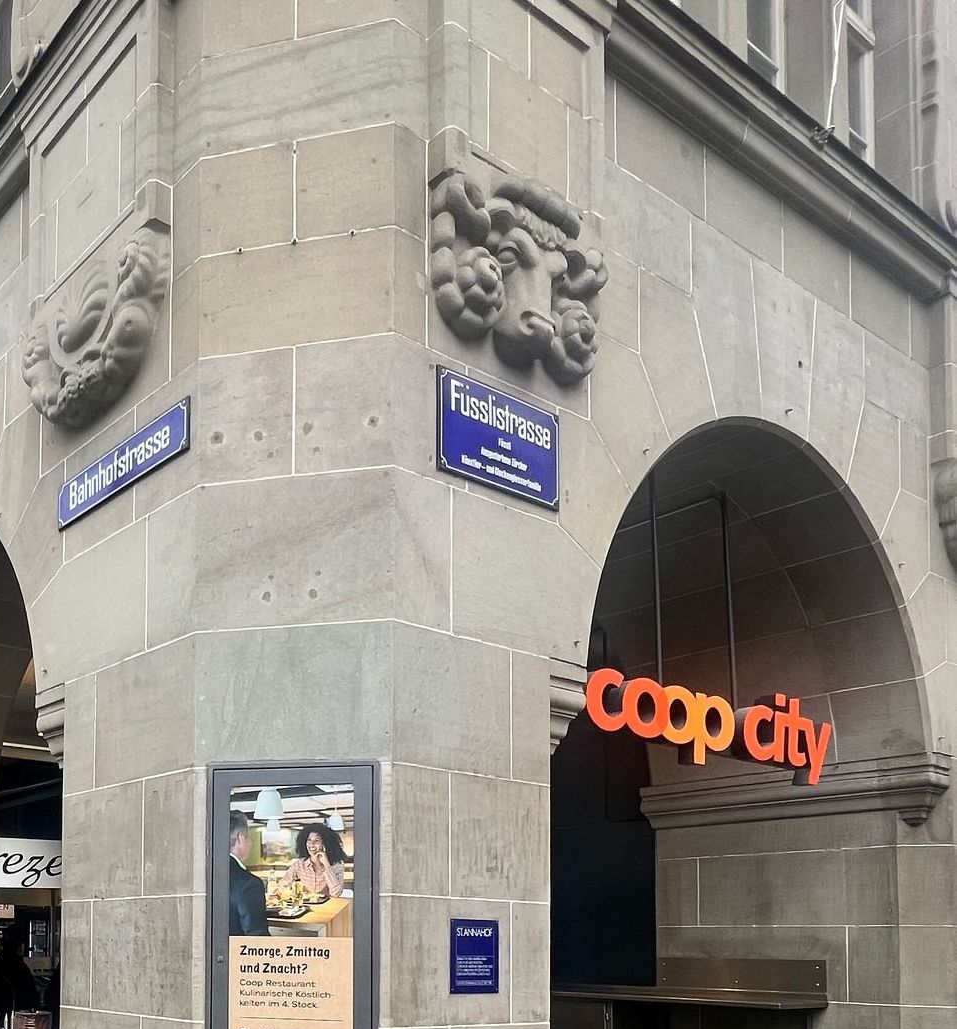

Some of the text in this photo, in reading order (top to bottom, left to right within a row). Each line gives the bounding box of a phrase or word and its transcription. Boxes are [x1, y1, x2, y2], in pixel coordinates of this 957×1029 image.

[451, 379, 551, 450] Füsslistrasse
[69, 425, 170, 511] Bahnhofstrasse
[586, 668, 832, 786] coop city
[240, 945, 330, 959] Zmorge, Zmittag
[240, 963, 308, 974] und Znacht?
[239, 979, 264, 987] Coop
[239, 989, 293, 998] Kulinarische
